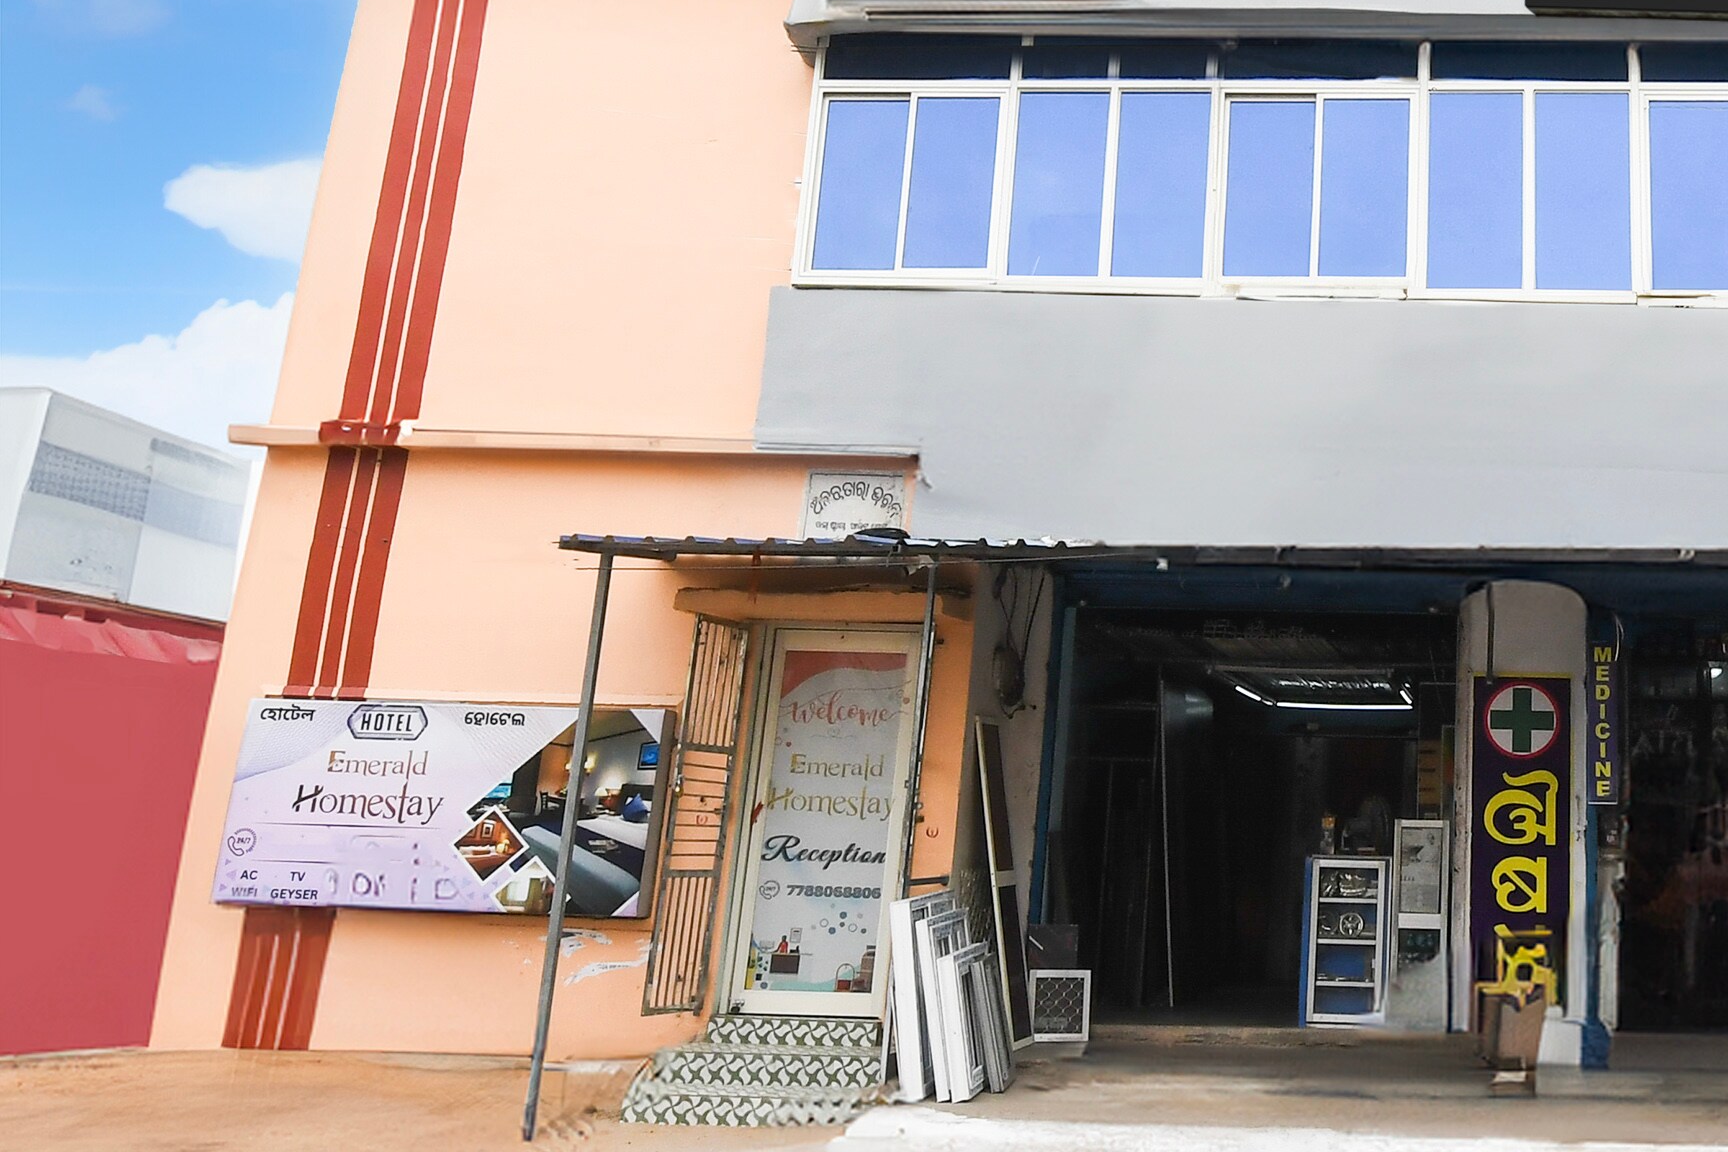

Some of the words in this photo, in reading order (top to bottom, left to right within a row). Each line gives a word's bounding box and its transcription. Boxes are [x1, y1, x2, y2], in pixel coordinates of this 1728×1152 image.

[260, 703, 316, 721] হোটেল
[360, 711, 414, 733] HOTEL
[464, 711, 526, 727] ହୋଟେଲ
[1593, 646, 1613, 798] MEDICINE
[327, 750, 428, 780] Emerald
[790, 753, 885, 781] Emerald
[292, 782, 444, 825] Homestay
[766, 786, 894, 821] Homestay
[761, 834, 887, 870] Reception
[240, 869, 258, 881] AC
[290, 871, 306, 882] TV
[270, 888, 319, 901] GEYSER
